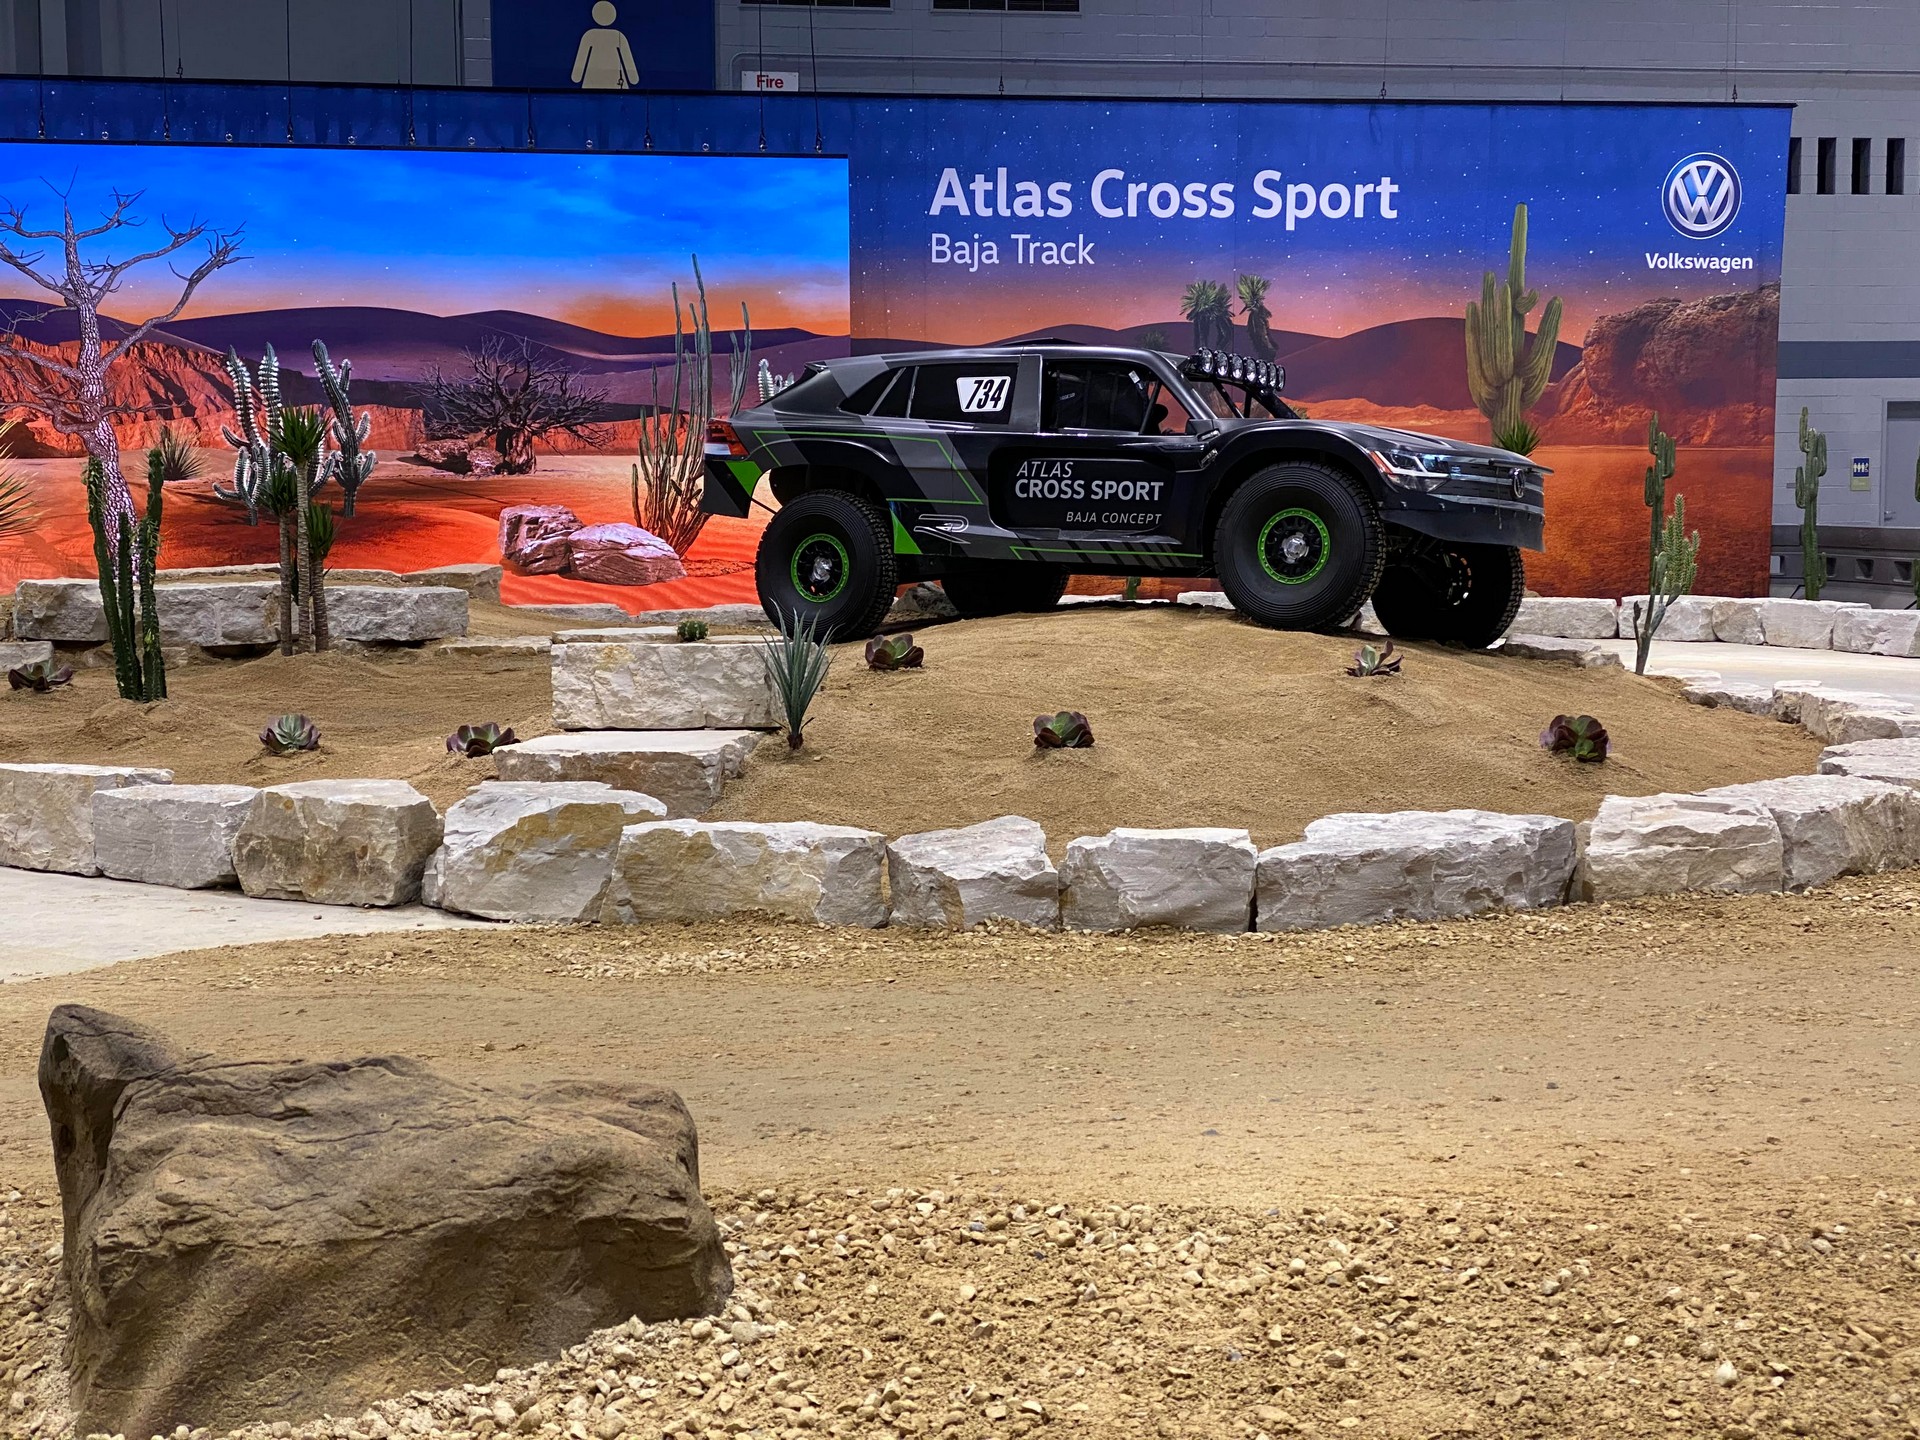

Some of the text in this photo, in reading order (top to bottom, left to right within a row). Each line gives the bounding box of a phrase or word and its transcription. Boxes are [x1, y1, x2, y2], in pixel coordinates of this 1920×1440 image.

[756, 74, 784, 89] Fire
[929, 167, 1400, 231] Atlas Cross Sport
[930, 233, 1096, 272] Baja Track
[1645, 252, 1753, 273] Volkswagen
[964, 379, 1007, 410] 734
[1016, 461, 1074, 478] ATLAS
[1015, 479, 1164, 501] CROSS SPORT
[1066, 511, 1162, 525] BAJA CONCEPT
